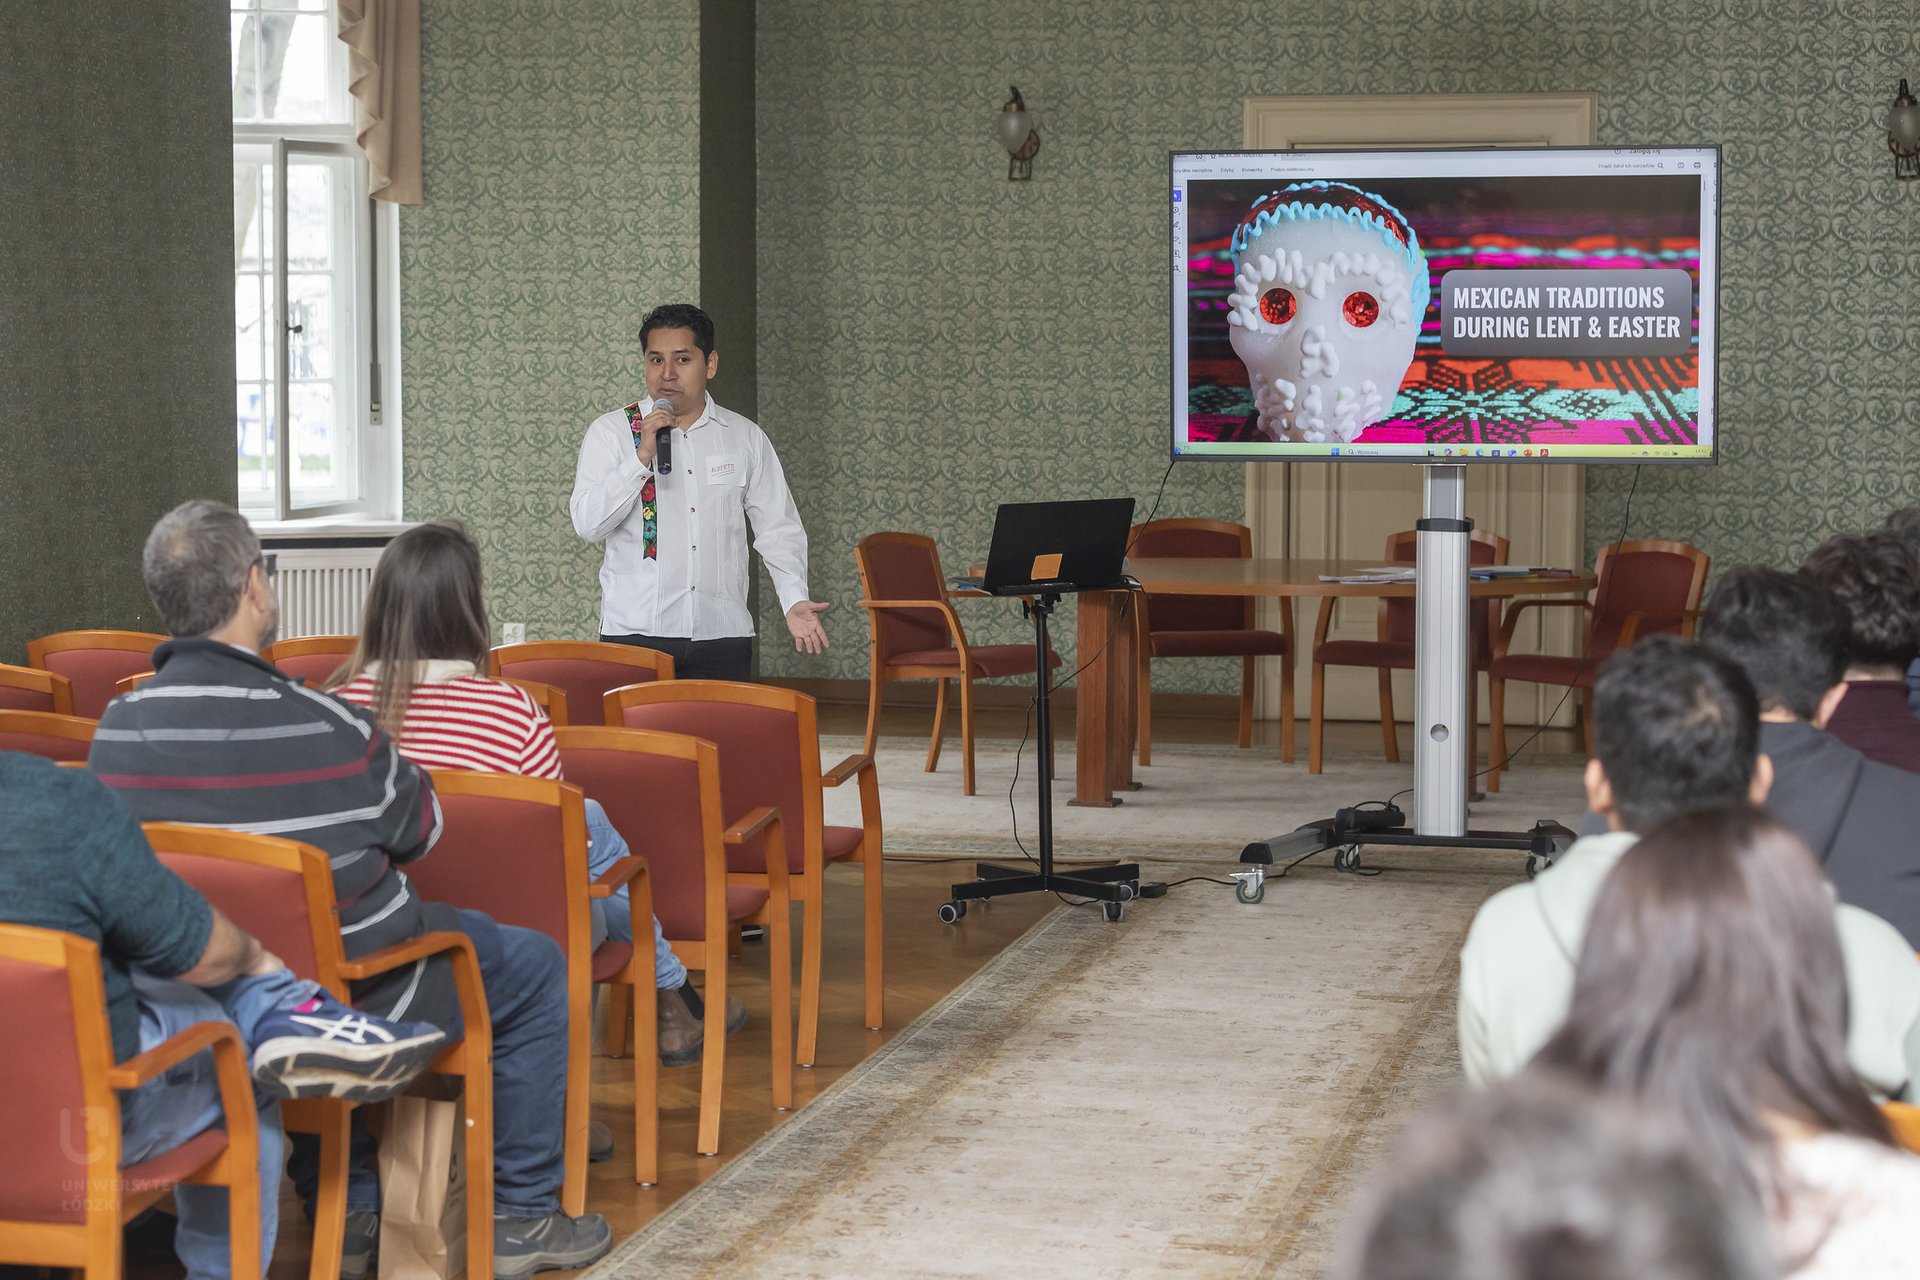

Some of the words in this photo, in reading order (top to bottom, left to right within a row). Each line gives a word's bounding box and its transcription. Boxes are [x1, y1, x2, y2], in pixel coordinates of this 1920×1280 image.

[1453, 287, 1540, 309] MEXICAN
[1546, 286, 1665, 309] TRADITIONS
[1453, 316, 1530, 338] DURING
[1536, 316, 1582, 338] LENT
[1587, 316, 1602, 338] &
[1608, 315, 1681, 338] EASTER
[711, 463, 735, 472] ALBERTO
